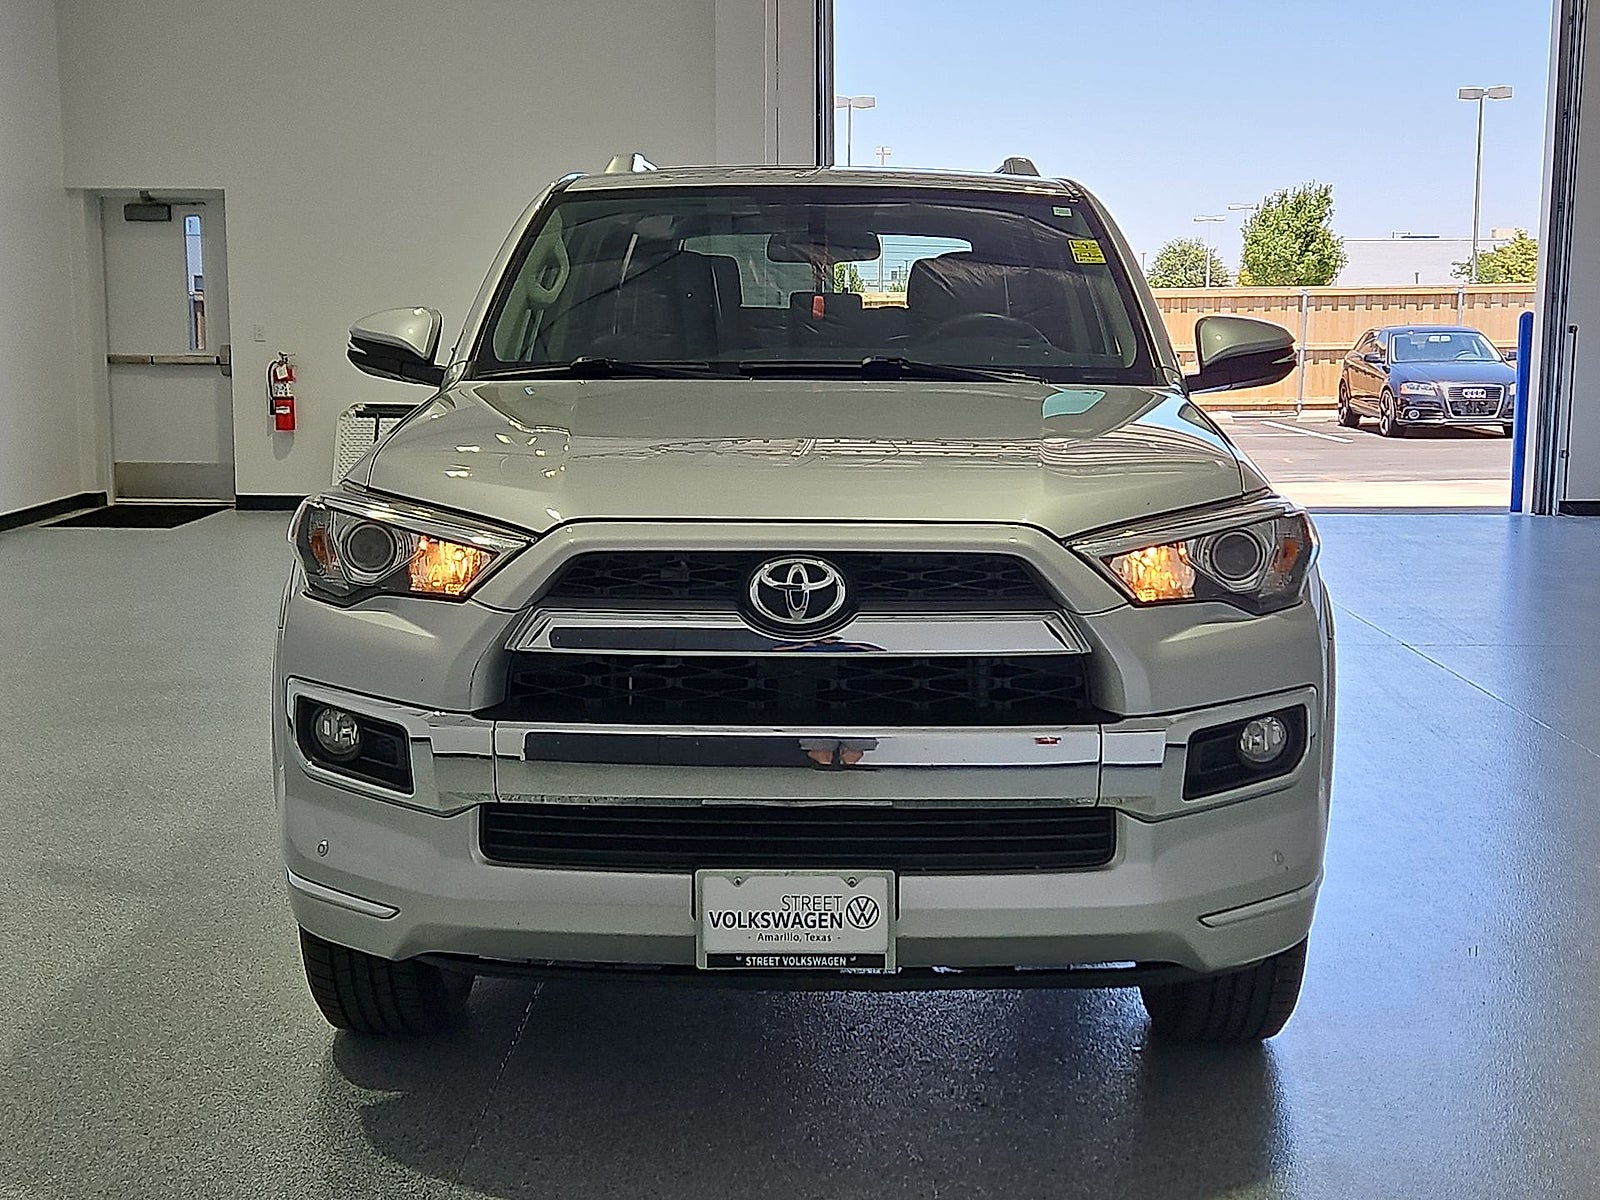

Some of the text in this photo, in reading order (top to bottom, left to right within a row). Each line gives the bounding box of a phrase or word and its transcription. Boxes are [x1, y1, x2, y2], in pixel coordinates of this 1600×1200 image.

[781, 895, 843, 911] STREET
[709, 912, 843, 929] VOLKSWAGEN
[757, 932, 832, 942] Amarillo, Texas
[745, 956, 847, 966] STREET VOLKSWAGEN
